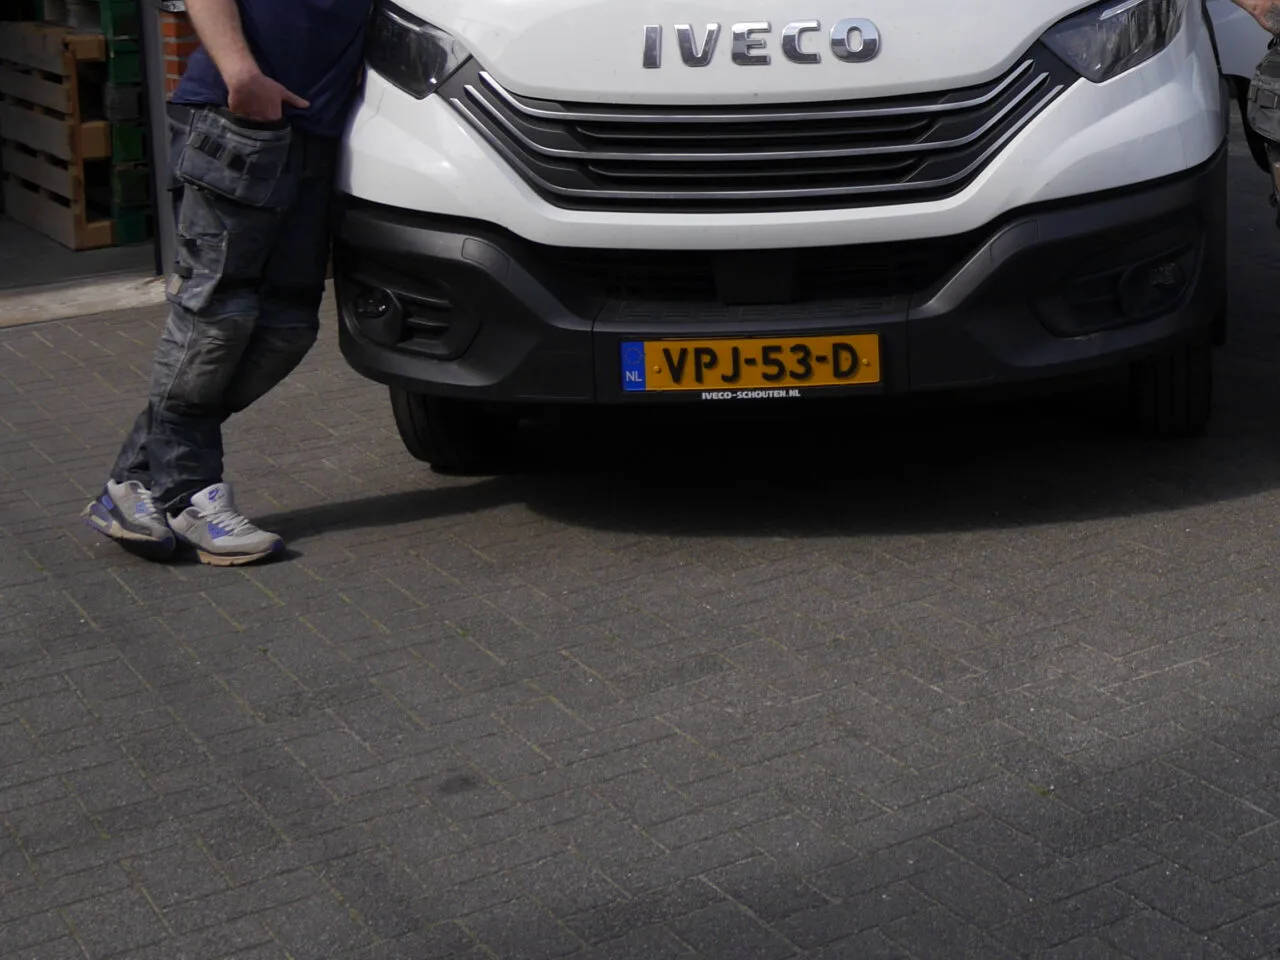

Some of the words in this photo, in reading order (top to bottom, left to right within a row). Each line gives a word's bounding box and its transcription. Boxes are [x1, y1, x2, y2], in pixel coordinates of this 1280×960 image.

[642, 17, 881, 69] IVECO
[626, 371, 642, 382] NL
[662, 343, 859, 384] VPJ-53-D
[701, 389, 801, 400] IVECO-SCHOUTEN.NL
